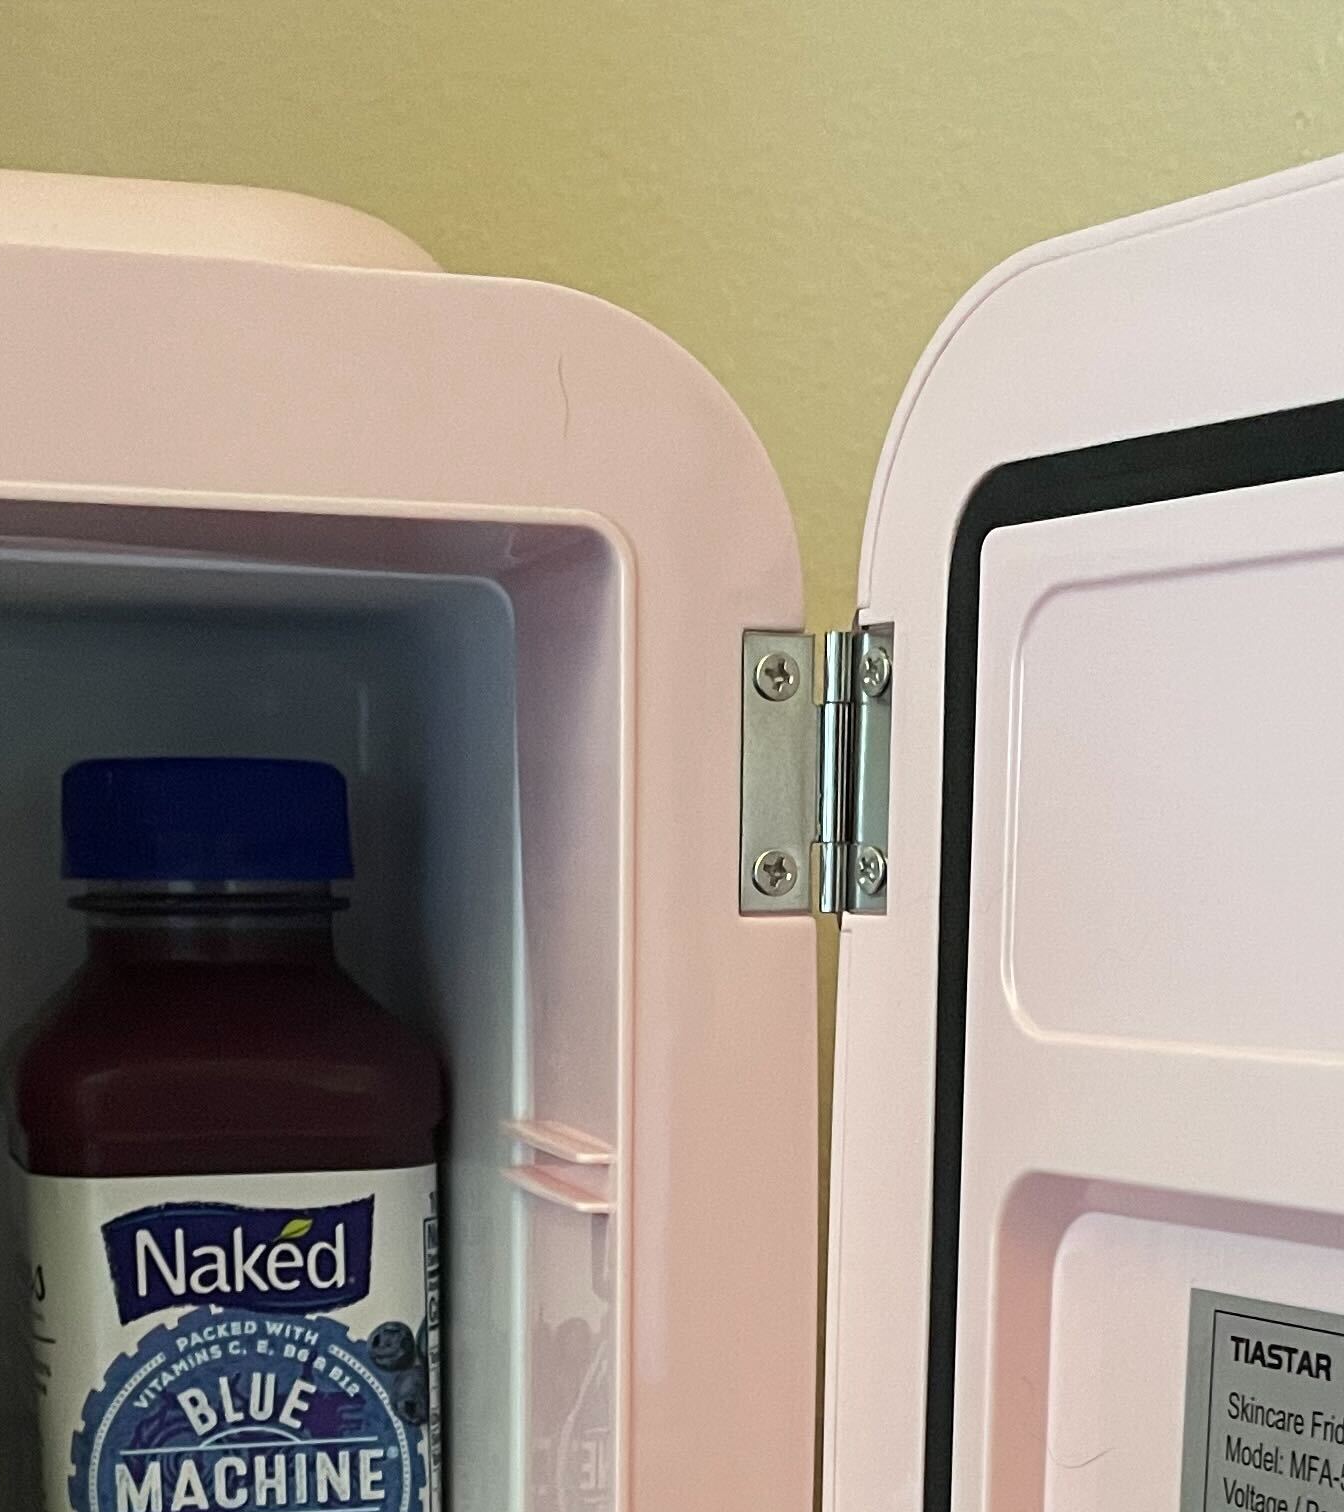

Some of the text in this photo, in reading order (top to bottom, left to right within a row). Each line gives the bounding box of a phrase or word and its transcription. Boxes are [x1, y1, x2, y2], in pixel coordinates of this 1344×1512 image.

[135, 1223, 346, 1297] Naked
[176, 1320, 319, 1352] PACKED WITH
[1231, 1335, 1332, 1381] TIASTAR
[133, 1344, 222, 1410] VITAMINS
[228, 1341, 247, 1355] C,
[257, 1340, 274, 1356] E,
[283, 1344, 308, 1362] B6
[329, 1366, 360, 1398] B12
[177, 1372, 317, 1436] BLUE
[1227, 1391, 1304, 1436] Skincare
[1226, 1435, 1284, 1476] Model:
